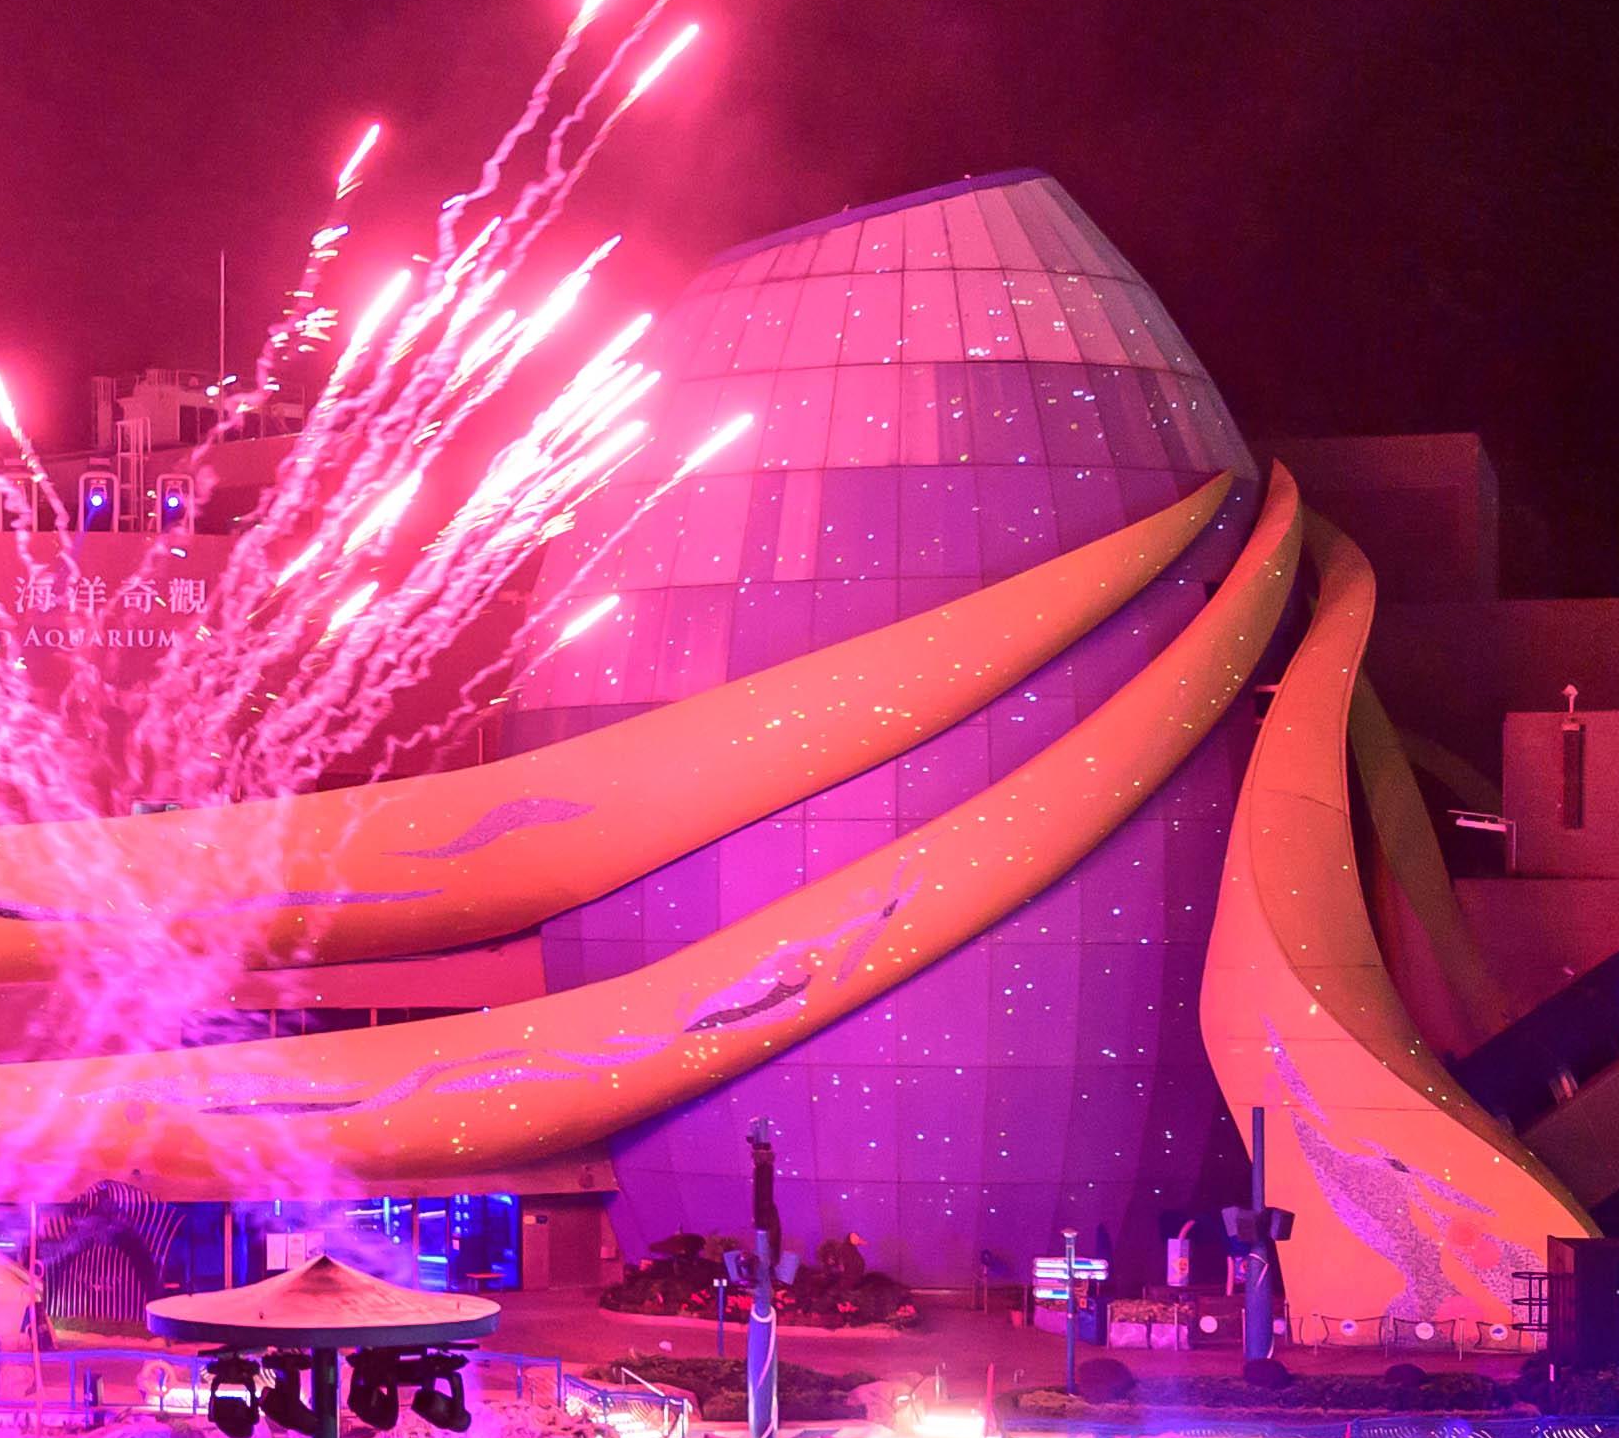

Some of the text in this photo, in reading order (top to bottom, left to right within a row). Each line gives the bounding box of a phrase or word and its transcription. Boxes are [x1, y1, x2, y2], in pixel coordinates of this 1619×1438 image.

[15, 576, 208, 614] 海洋奇觀
[23, 625, 179, 650] AQUARIUM
